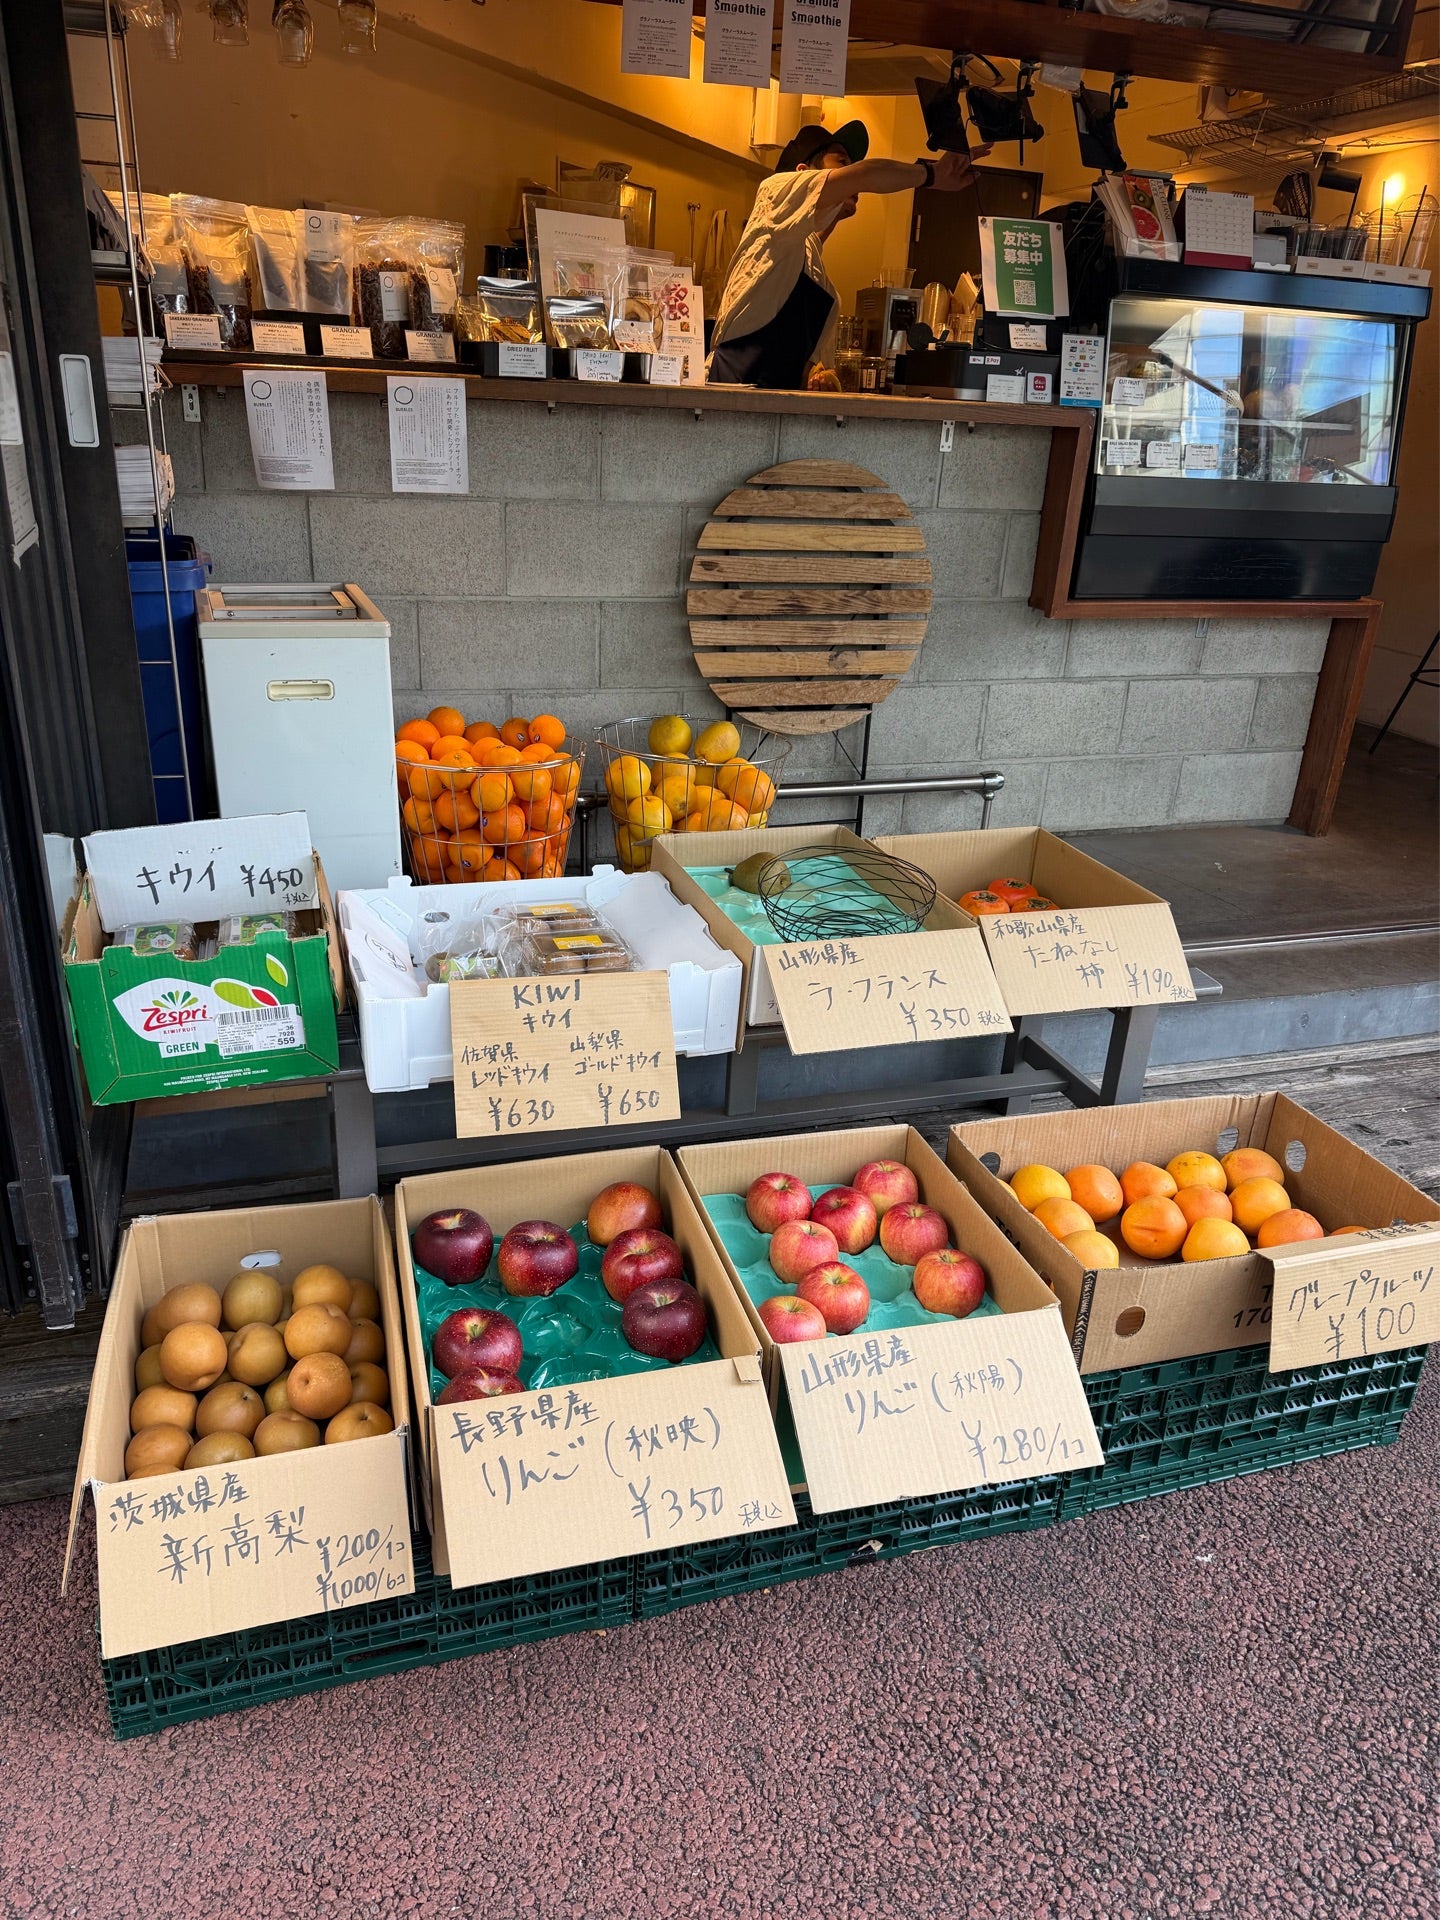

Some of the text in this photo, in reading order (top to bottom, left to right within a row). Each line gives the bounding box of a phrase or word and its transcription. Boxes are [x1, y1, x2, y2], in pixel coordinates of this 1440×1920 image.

[714, 0, 766, 16] Smoothie
[791, 11, 842, 26] Smoothie
[1002, 230, 1042, 248] 友だち
[1003, 248, 1043, 266] 募集中
[580, 290, 604, 298] BUBBLES
[445, 388, 454, 472] にあわせて開発したグラノーラ
[240, 864, 303, 897] ¥450
[282, 891, 311, 906] 税込
[992, 913, 1088, 939] 和歌山県産
[778, 941, 865, 972] 山形県産
[1023, 939, 1119, 969] たねなし
[808, 968, 947, 1011] ラ・フランス
[1076, 964, 1104, 990] 柿
[1125, 962, 1195, 999] ¥190 税込
[511, 978, 581, 1010] KIWI
[140, 1004, 208, 1032] Zespri
[163, 1026, 197, 1035] KIWIFRUIT
[522, 1008, 572, 1034] キウイ
[900, 1001, 1005, 1041] ¥350 税込
[166, 1041, 200, 1054] GREEN
[277, 1036, 296, 1045] 559
[460, 1042, 519, 1065] 佐賀県
[570, 1029, 624, 1053] 山梨県
[471, 1063, 550, 1089] レッドキウイ
[574, 1051, 661, 1076] ゴールドキウイ
[488, 1096, 555, 1132] ¥630
[597, 1083, 660, 1124] ¥650
[1288, 1266, 1434, 1322] グレープフルーツ
[1323, 1301, 1416, 1360] ¥100
[800, 1334, 918, 1394] 山形県産
[450, 1389, 602, 1454] 長野県産
[960, 1419, 1085, 1479] ¥280/1コ
[109, 1471, 250, 1532] 茨城県産
[627, 1475, 783, 1539] ¥350 税込
[157, 1505, 310, 1585] 新高梨
[316, 1524, 405, 1573] ¥200/1コ
[315, 1567, 406, 1611] ¥1,000/6コ
